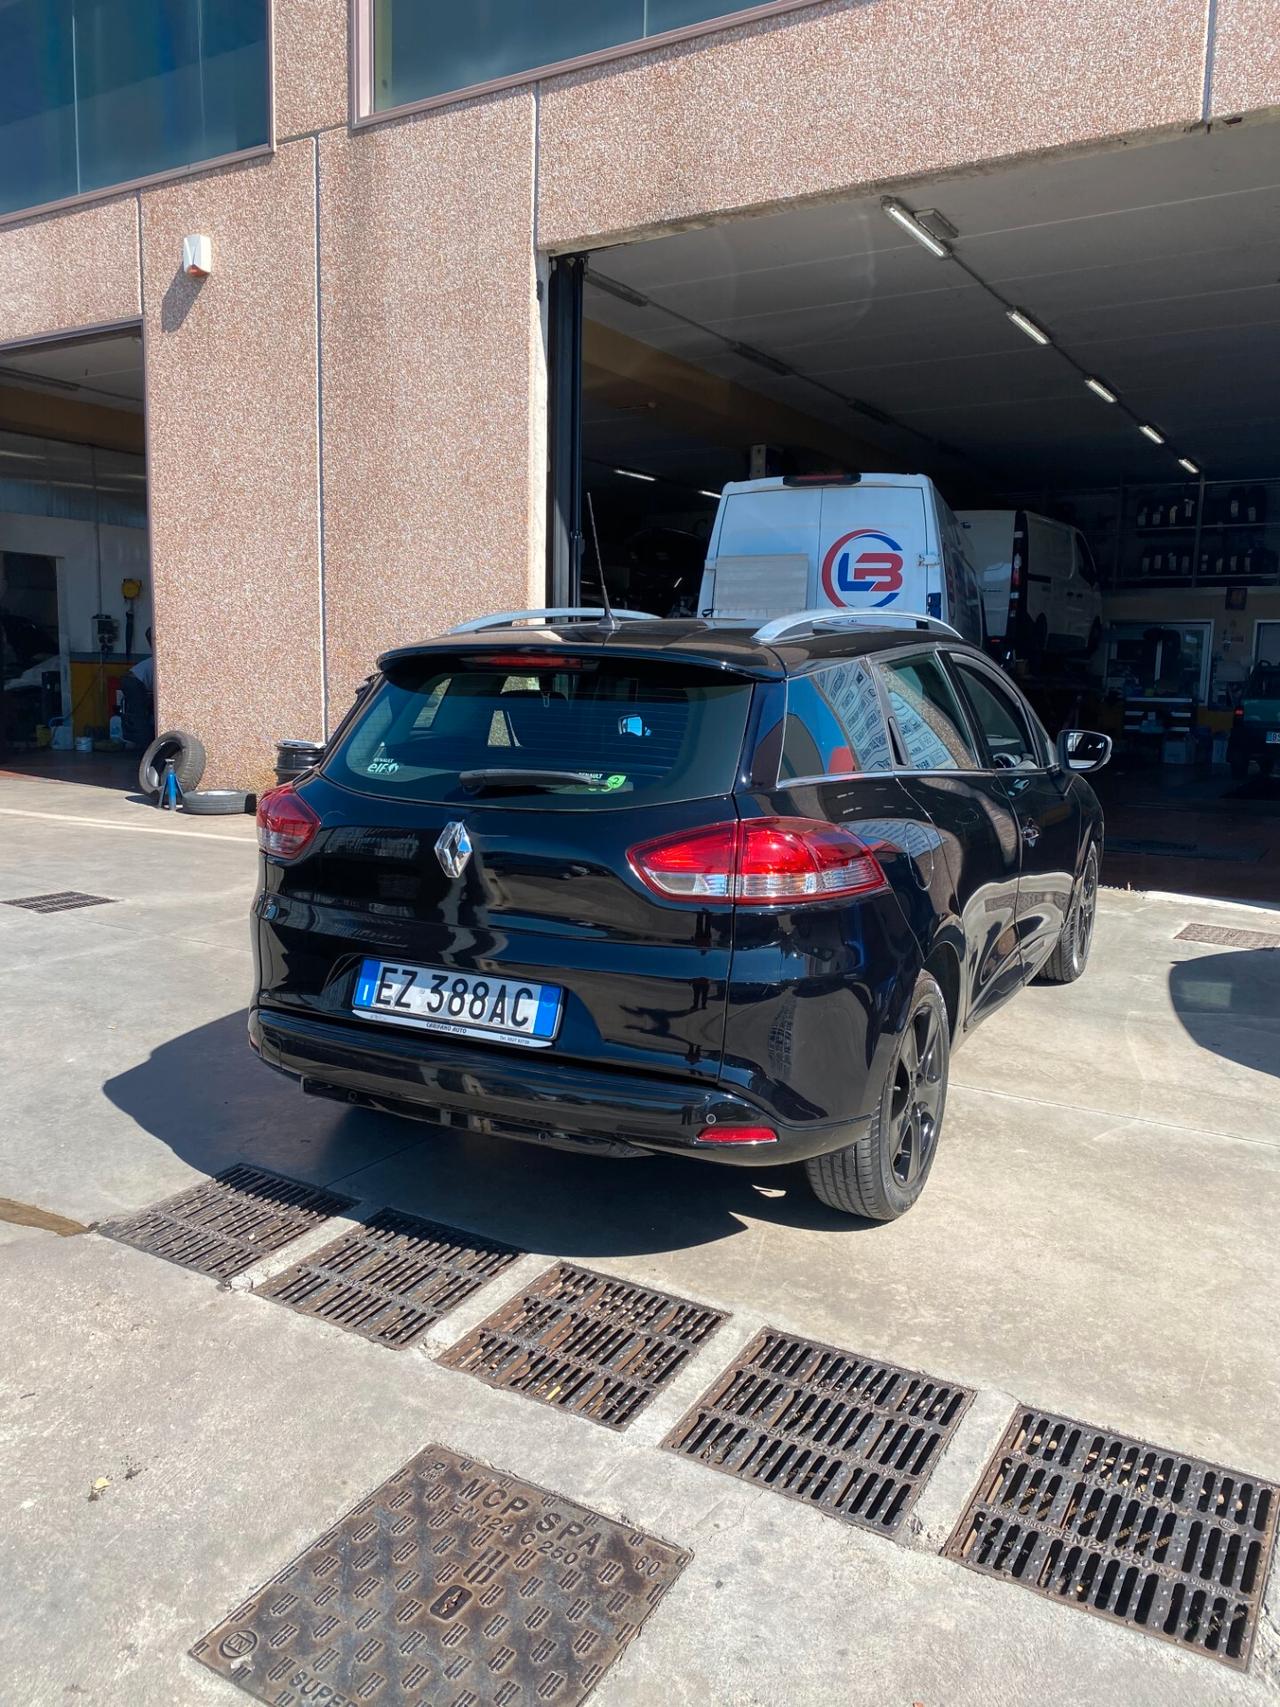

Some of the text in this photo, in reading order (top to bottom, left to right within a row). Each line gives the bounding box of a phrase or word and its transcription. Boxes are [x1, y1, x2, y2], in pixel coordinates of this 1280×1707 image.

[838, 553, 903, 591] LB
[375, 966, 418, 1009] EZ
[426, 974, 533, 1027] 388AC
[450, 1502, 579, 1567] EN 124 C 250
[458, 1478, 602, 1556] MCP SPA
[634, 1555, 661, 1577] 60
